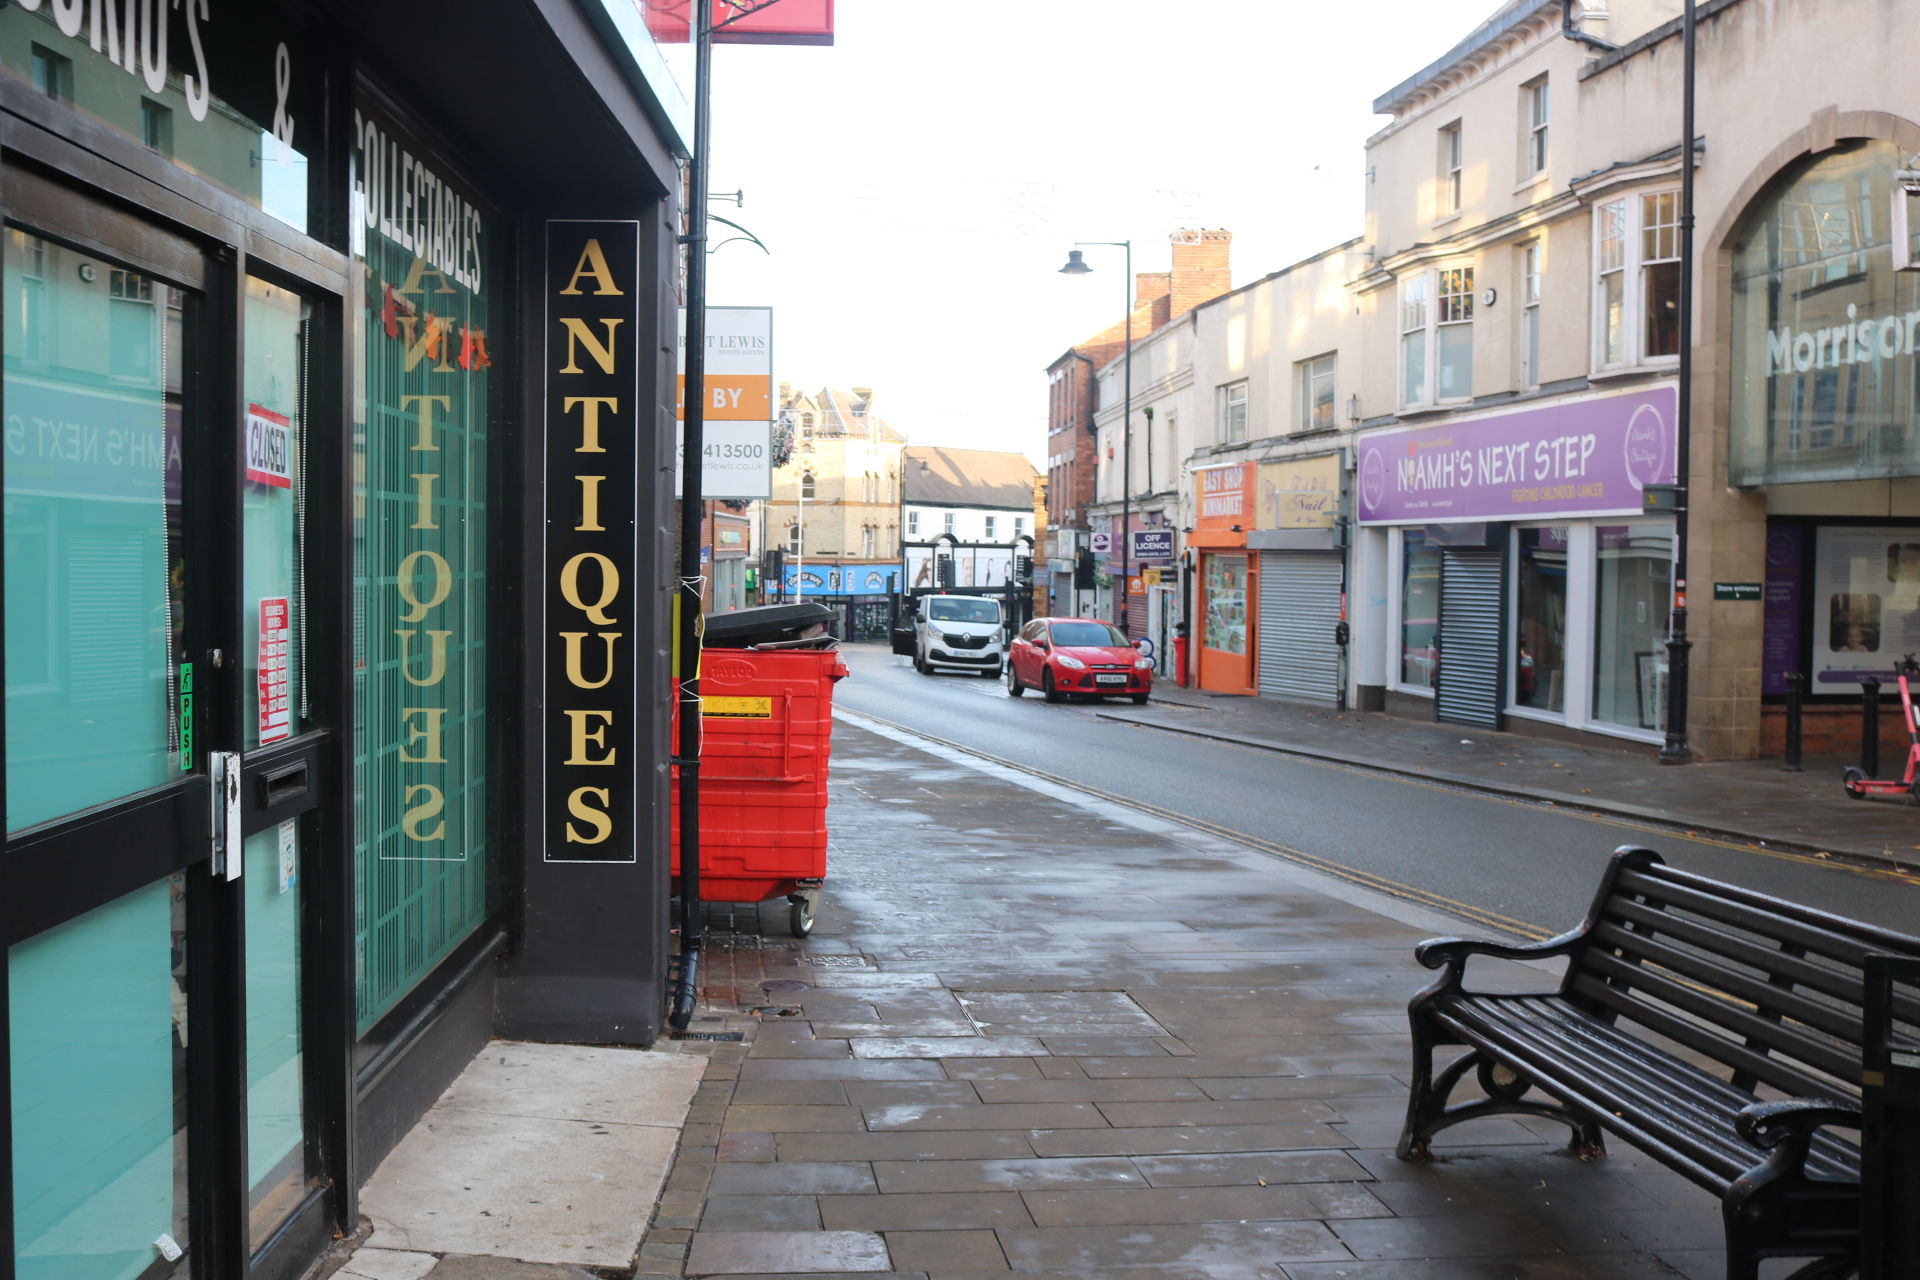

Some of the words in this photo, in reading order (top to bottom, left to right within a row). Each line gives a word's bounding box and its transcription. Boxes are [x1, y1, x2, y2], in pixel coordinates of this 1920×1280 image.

[273, 42, 295, 170] &
[720, 336, 765, 348] LEWIS
[713, 387, 743, 408] BY
[250, 420, 286, 474] CLOSED
[1478, 441, 1530, 486] NEXT
[1534, 433, 1596, 481] STEP
[1203, 470, 1223, 492] EASY
[1224, 467, 1244, 490] SHOP
[1540, 484, 1577, 500] CHILDHOOD
[1577, 482, 1604, 498] CANCER
[1202, 495, 1244, 516] MINIMARKET
[559, 238, 624, 845] ANTIQUES
[1135, 542, 1171, 550] LICENCE
[1144, 534, 1161, 542] OFF
[711, 666, 752, 678] TAYLOR
